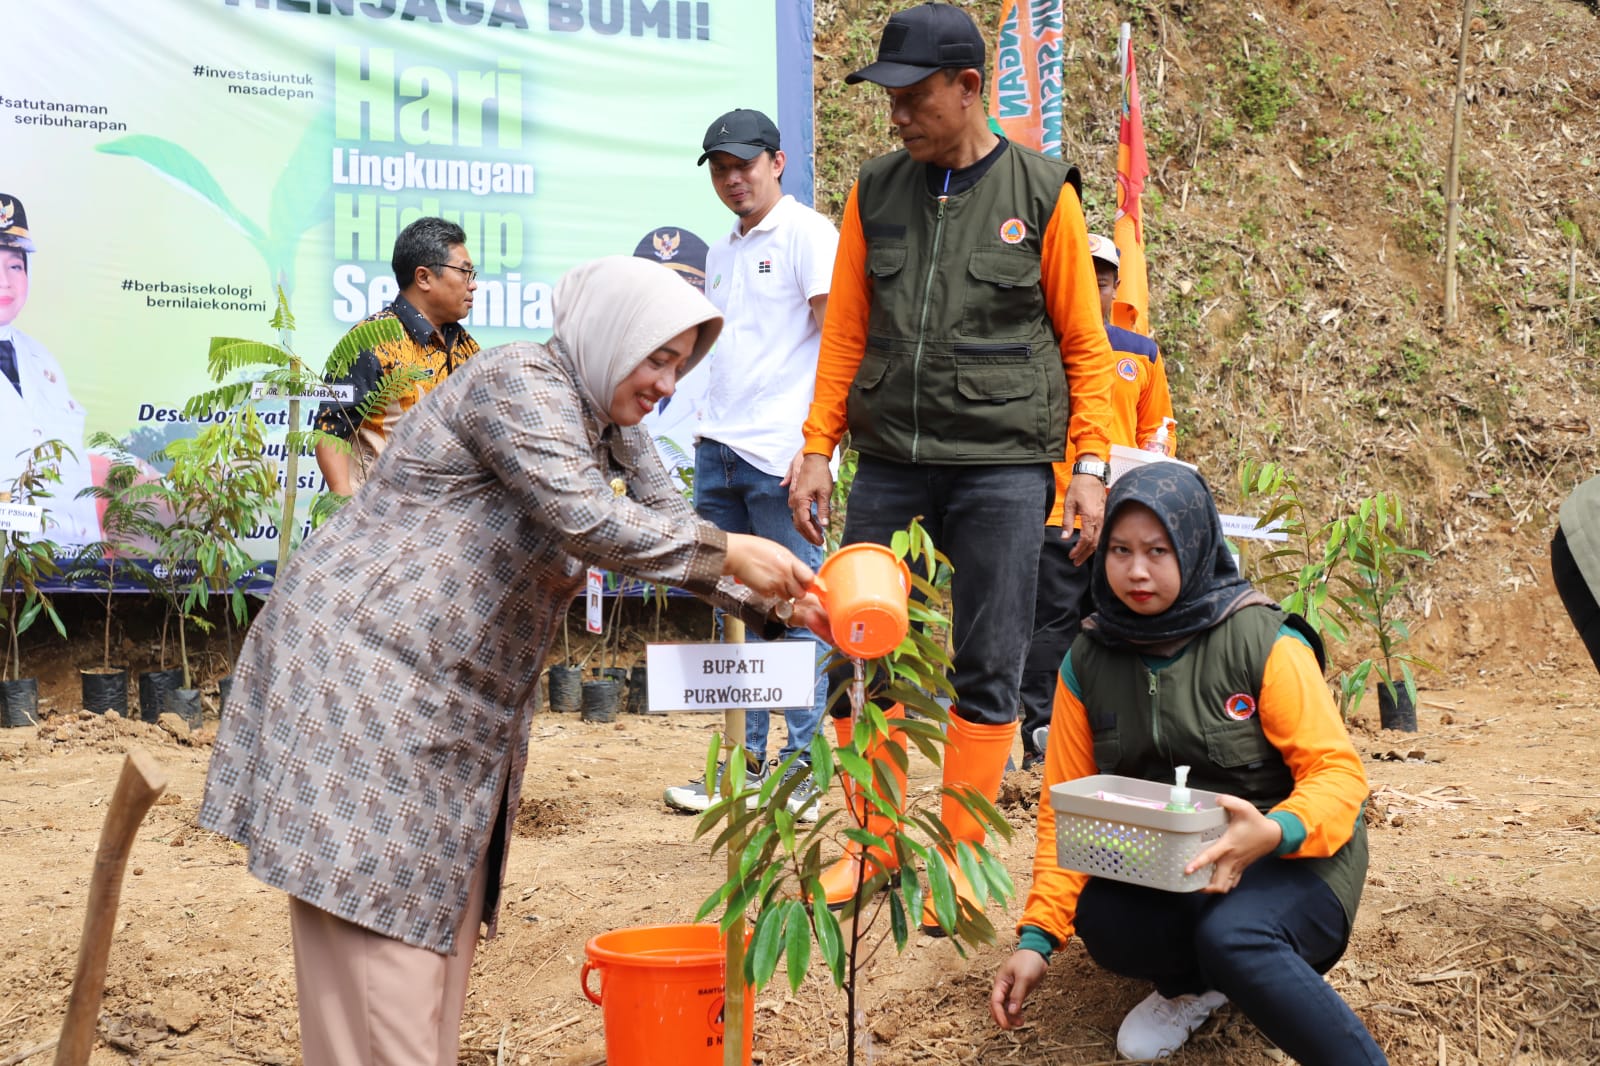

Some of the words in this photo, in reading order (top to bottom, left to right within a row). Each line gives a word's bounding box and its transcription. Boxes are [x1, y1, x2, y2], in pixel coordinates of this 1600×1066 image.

[193, 65, 313, 85] #investasiuntuk
[228, 84, 314, 100] masadepan
[335, 45, 522, 148] Hari
[15, 114, 127, 132] seribuharapan
[333, 147, 534, 195] Lingkungan
[121, 279, 253, 299] #berbasisekologi
[147, 296, 266, 312] bernilaiekonomi
[703, 660, 764, 674] BUPATI
[684, 685, 782, 704] PURWOREJO
